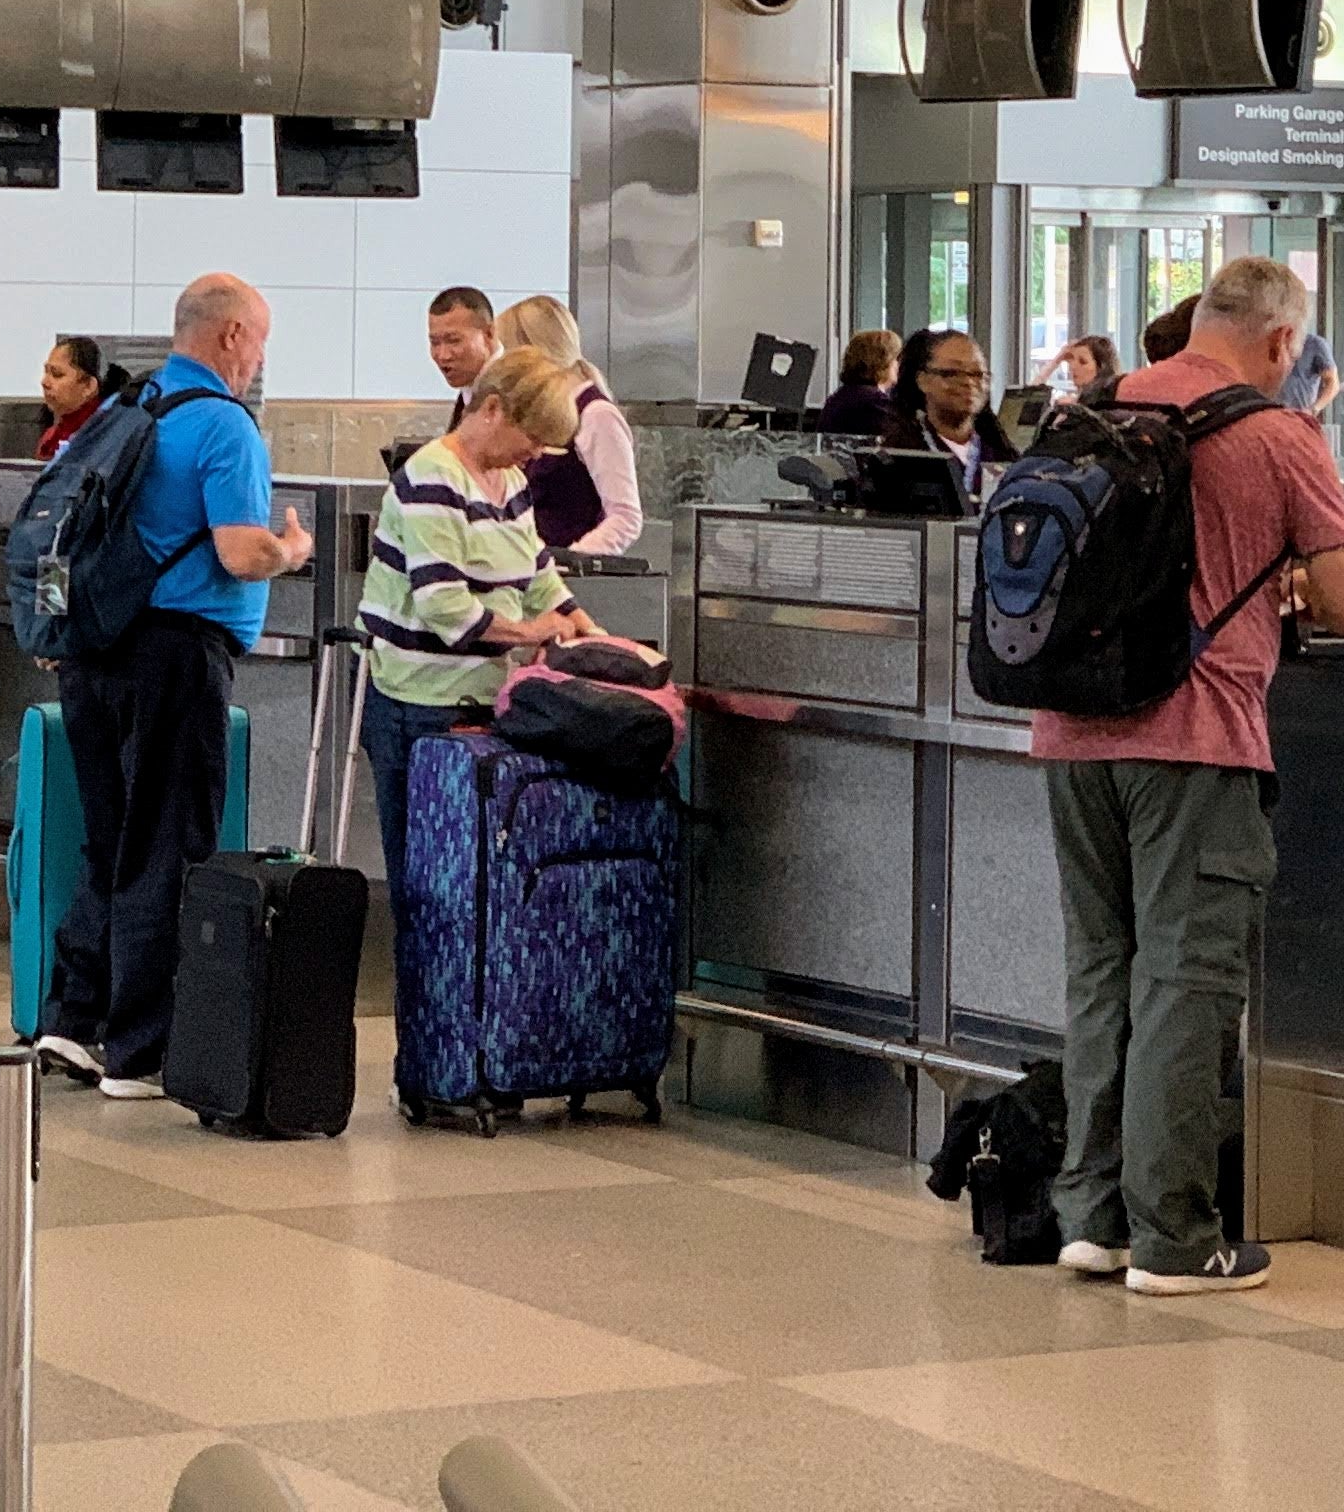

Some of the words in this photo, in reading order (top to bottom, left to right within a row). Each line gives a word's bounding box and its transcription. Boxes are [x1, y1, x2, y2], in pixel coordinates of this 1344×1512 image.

[1235, 103, 1289, 123] Parking
[1293, 106, 1344, 123] Garage
[1285, 127, 1344, 144] Terminal
[1198, 146, 1279, 166] Designated
[1282, 149, 1344, 168] Smoking
